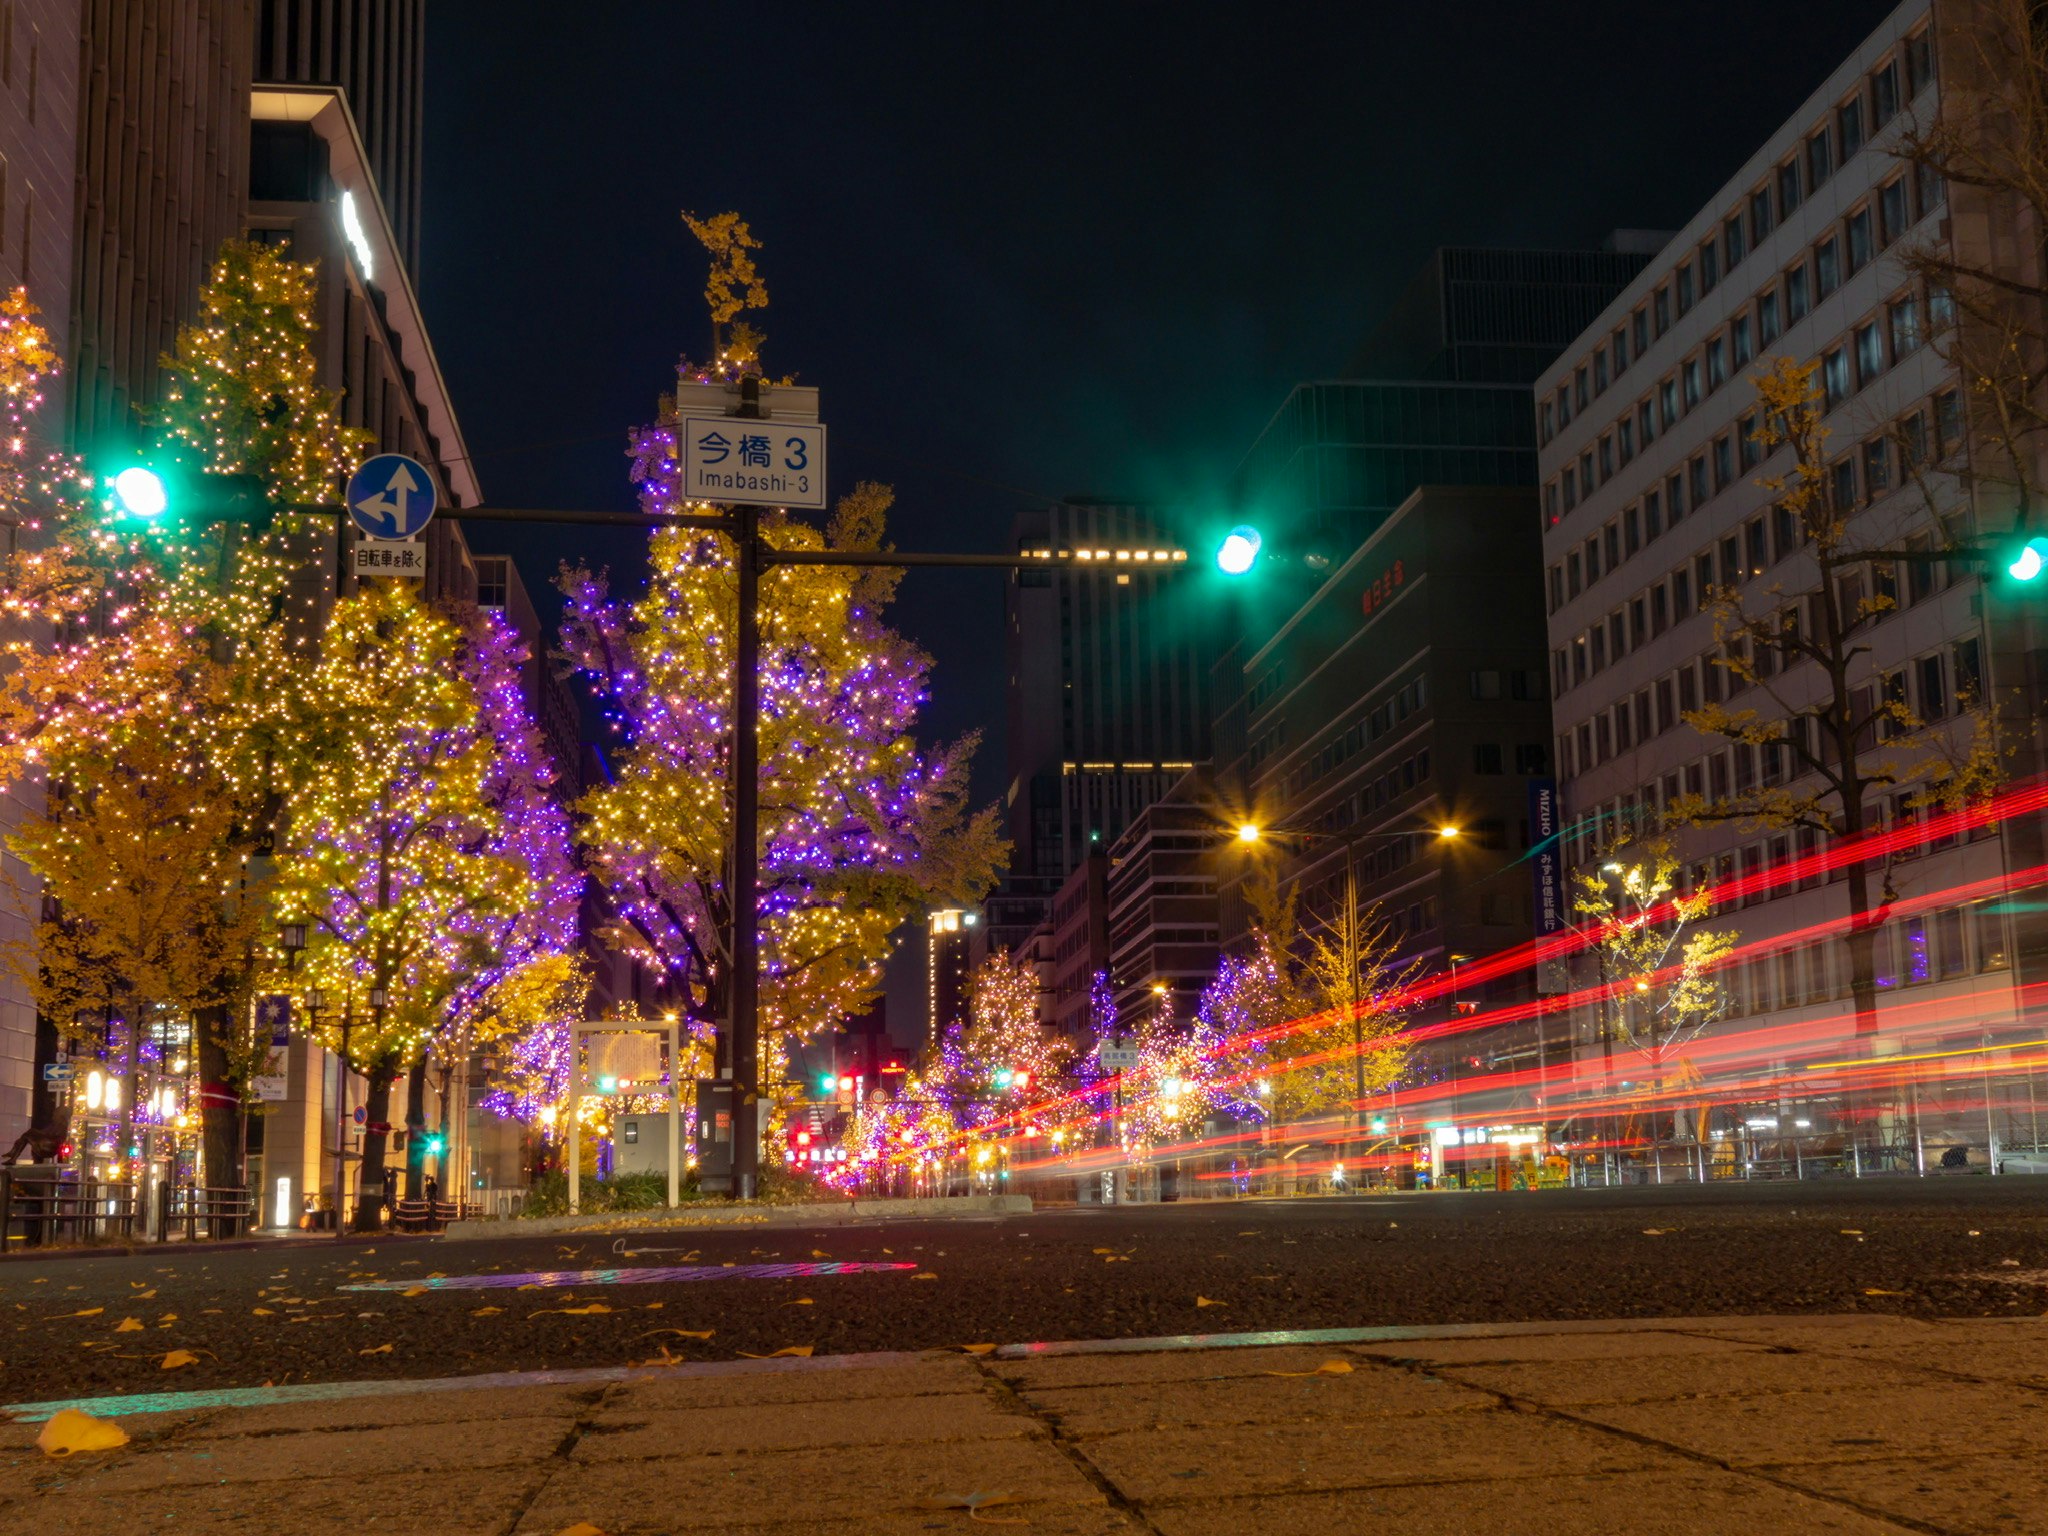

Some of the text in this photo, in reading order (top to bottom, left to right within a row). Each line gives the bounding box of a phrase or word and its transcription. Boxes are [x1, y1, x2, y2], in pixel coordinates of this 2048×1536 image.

[699, 469, 809, 493] Imabashi-3
[357, 548, 422, 568] 自転車を除く
[1539, 789, 1551, 836] MIZUHO
